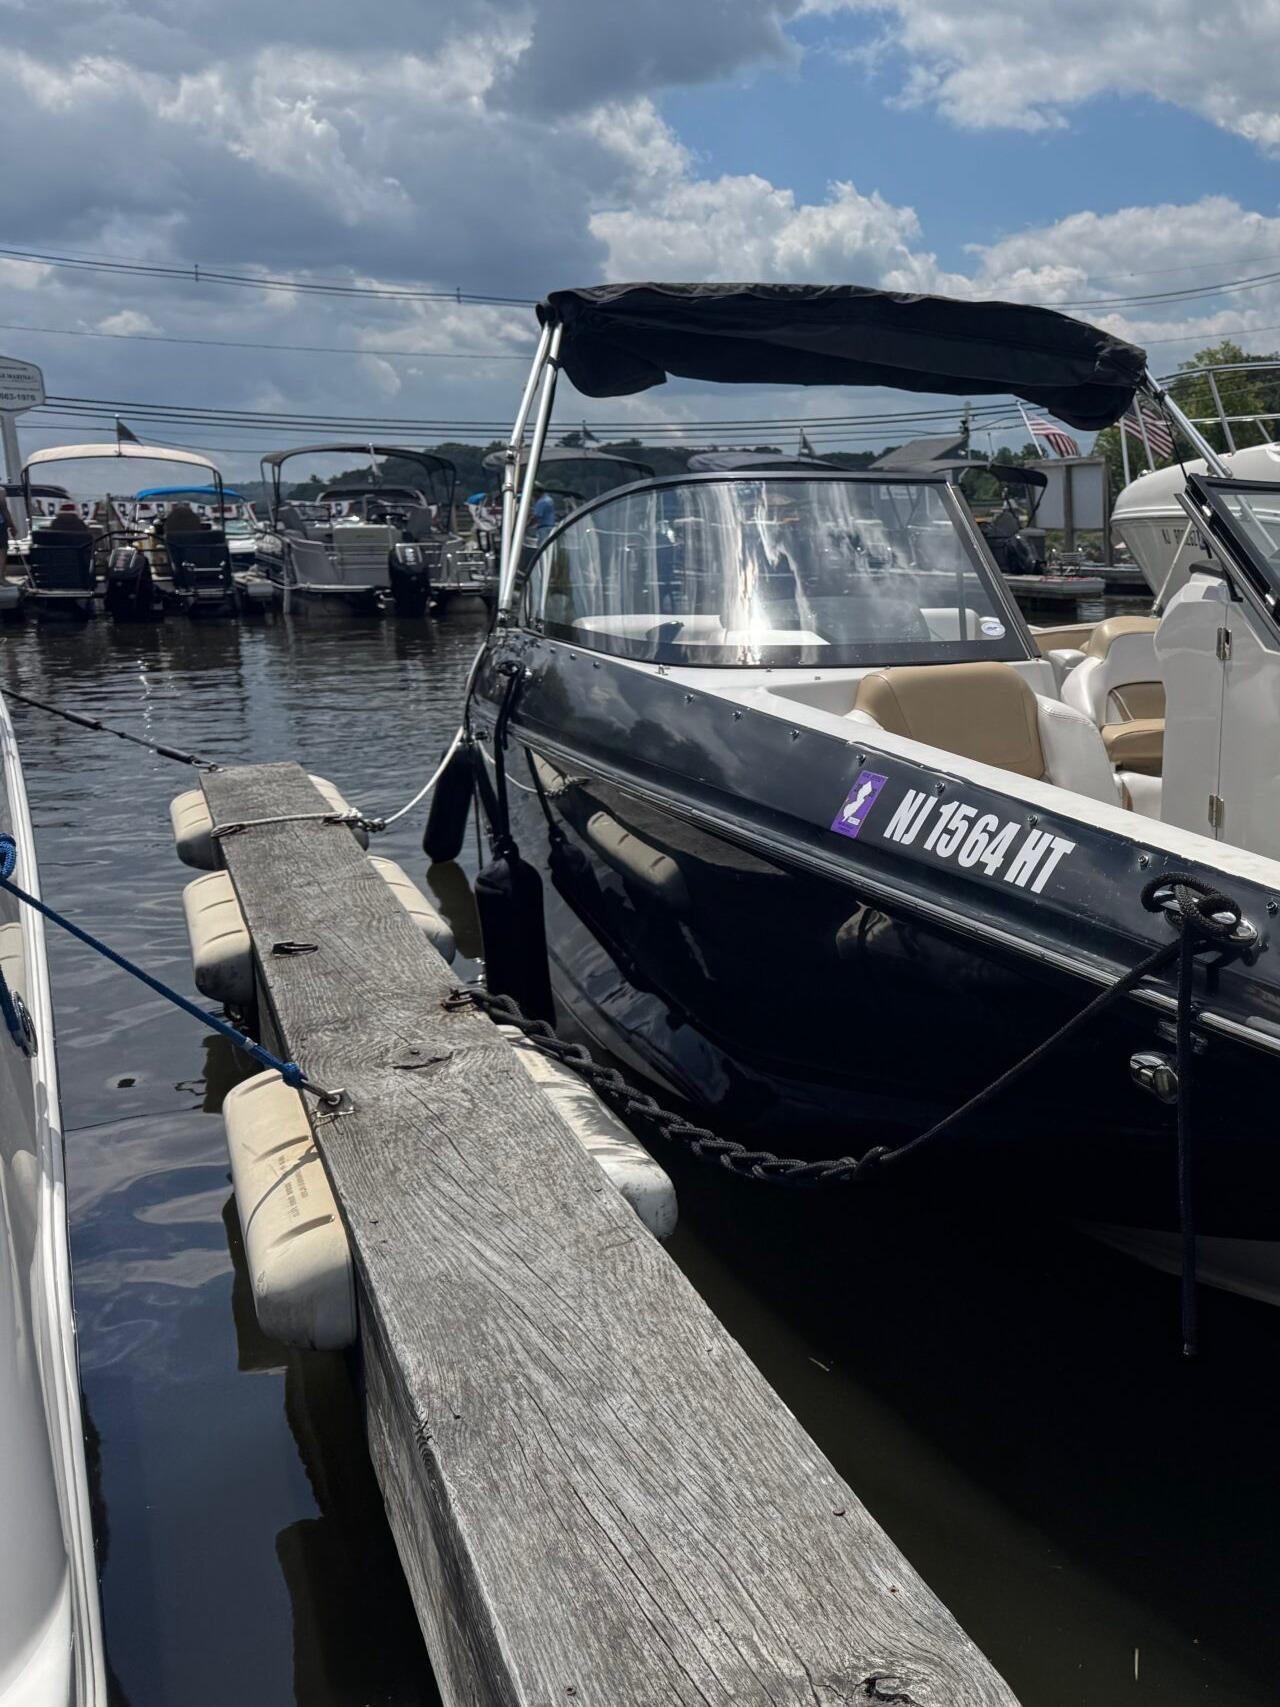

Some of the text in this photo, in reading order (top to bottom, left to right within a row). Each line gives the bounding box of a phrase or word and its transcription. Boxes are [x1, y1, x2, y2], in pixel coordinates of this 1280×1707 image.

[883, 789, 1076, 894] NJ 1564 HT
